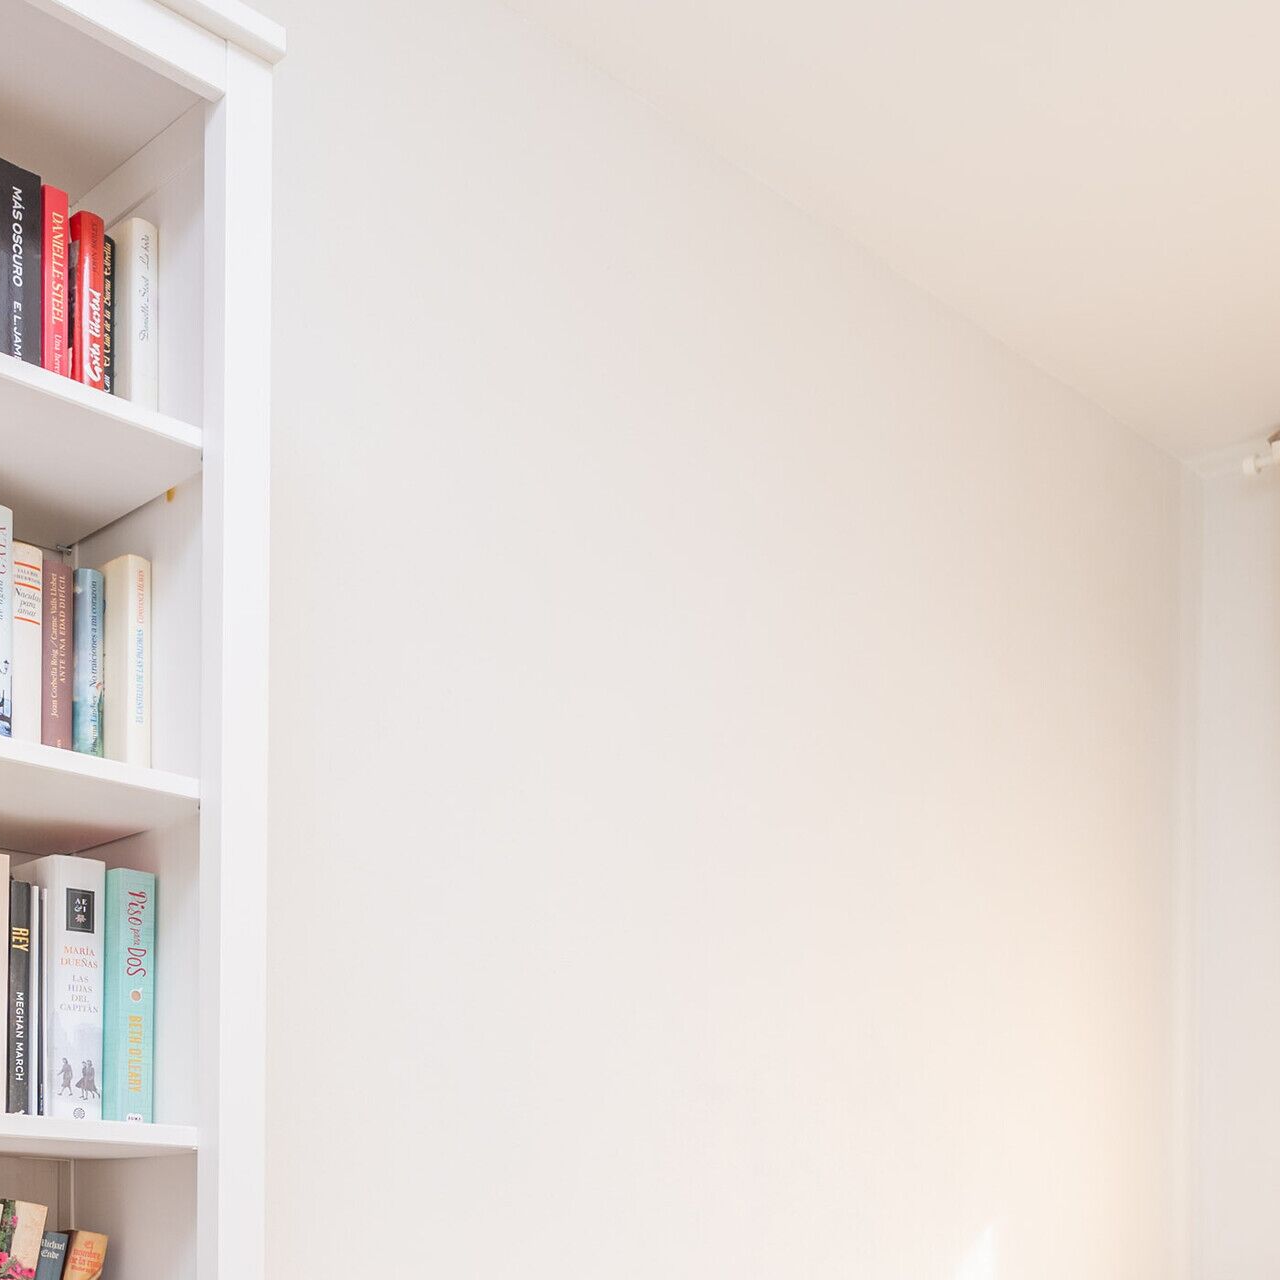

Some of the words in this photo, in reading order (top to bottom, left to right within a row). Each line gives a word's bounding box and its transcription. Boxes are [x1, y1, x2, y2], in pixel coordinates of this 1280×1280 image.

[12, 186, 23, 220] MÁS
[12, 222, 23, 287] OSCURO
[52, 211, 64, 279] DANIELLE
[52, 280, 64, 324] STEEL
[12, 927, 29, 953] REY
[64, 946, 95, 958] MARÍA
[15, 991, 25, 1038] MEGHAN
[15, 1044, 24, 1082] MARCH
